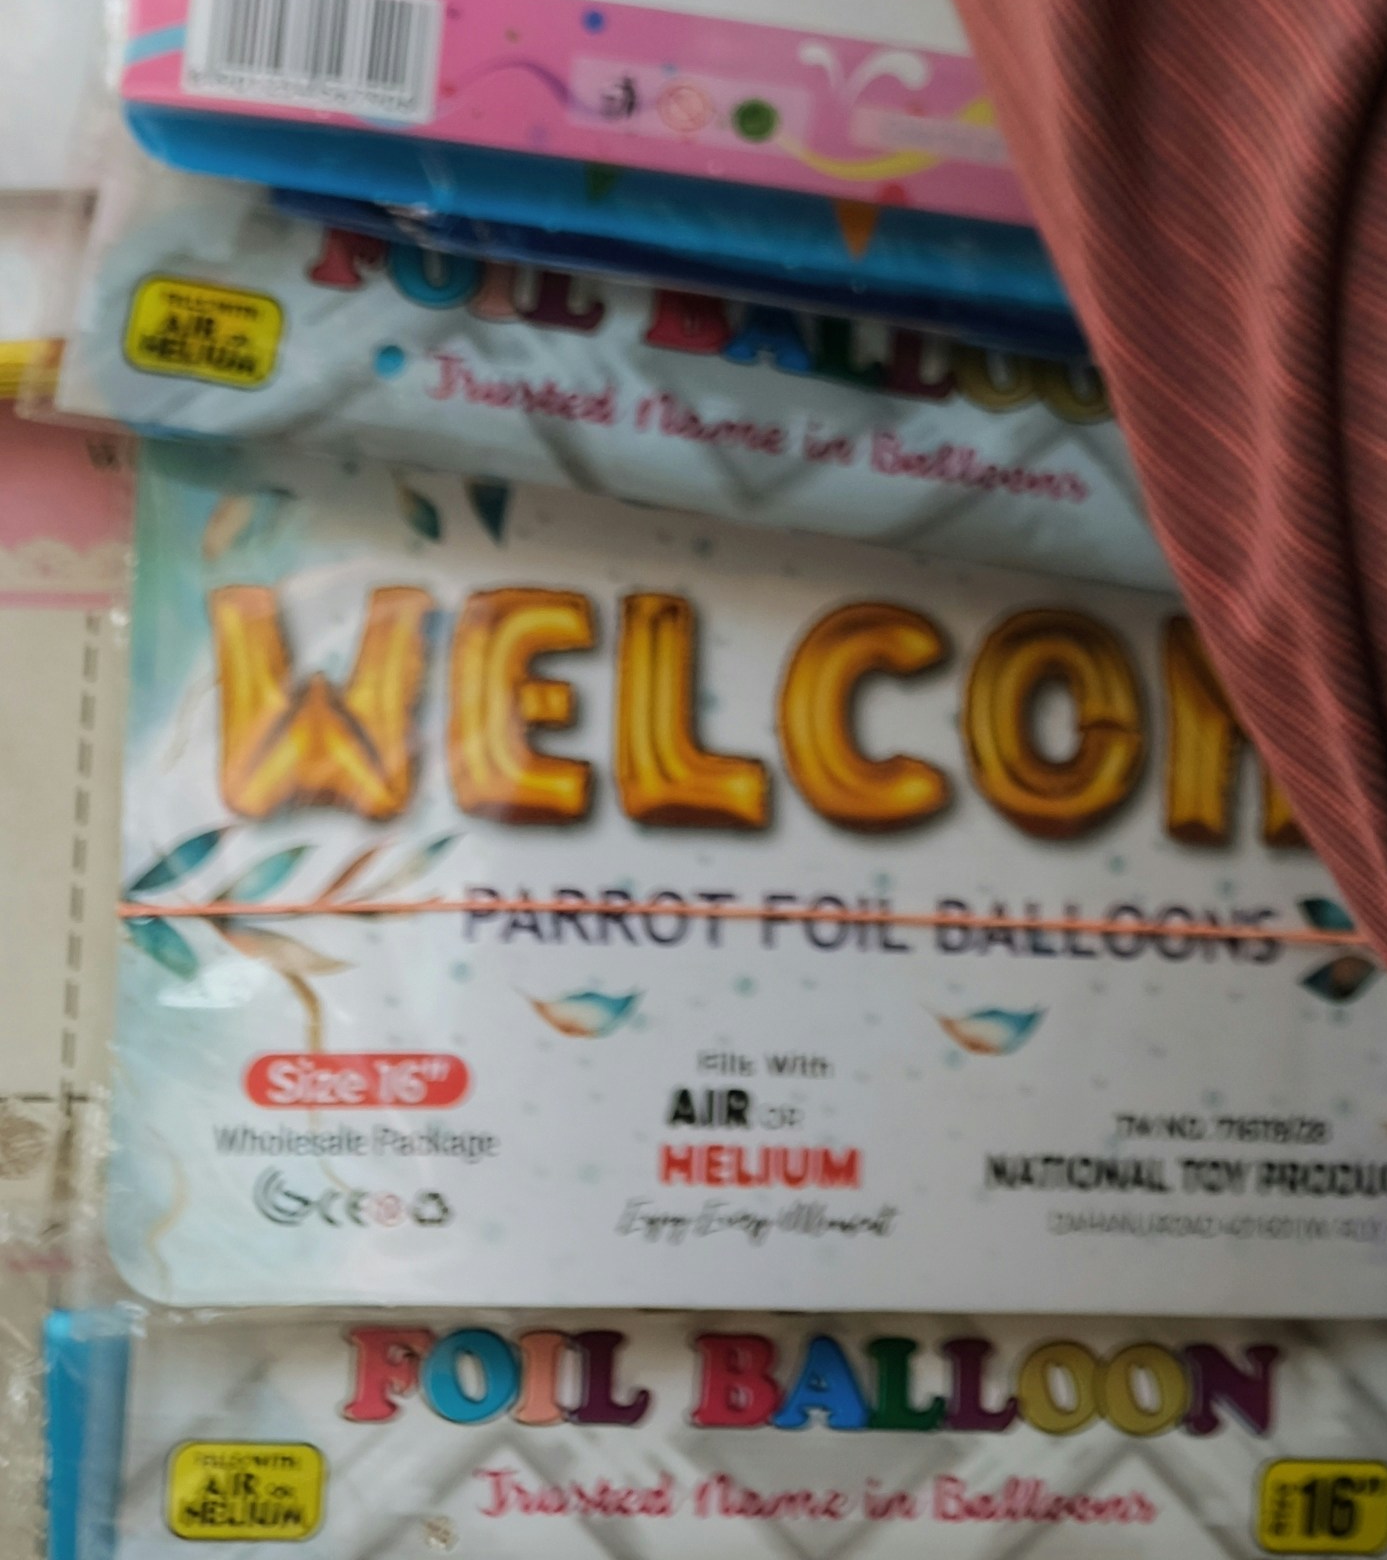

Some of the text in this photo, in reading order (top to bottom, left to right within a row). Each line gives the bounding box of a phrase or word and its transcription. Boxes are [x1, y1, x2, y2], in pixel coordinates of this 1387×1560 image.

[463, 886, 1284, 967] PARROT FOIL BALLOONS
[266, 1059, 366, 1104] Size
[665, 1088, 750, 1127] AIR
[214, 1124, 366, 1158] Wholesale
[660, 1145, 861, 1188] HELIUM
[984, 1155, 1172, 1194] NATIONAL
[1177, 1157, 1245, 1197] TOY
[344, 1327, 1281, 1438] FOIL BALLOON
[474, 1467, 675, 1518] Trusted
[692, 1474, 847, 1522] Name
[934, 1474, 1156, 1524] Balloons
